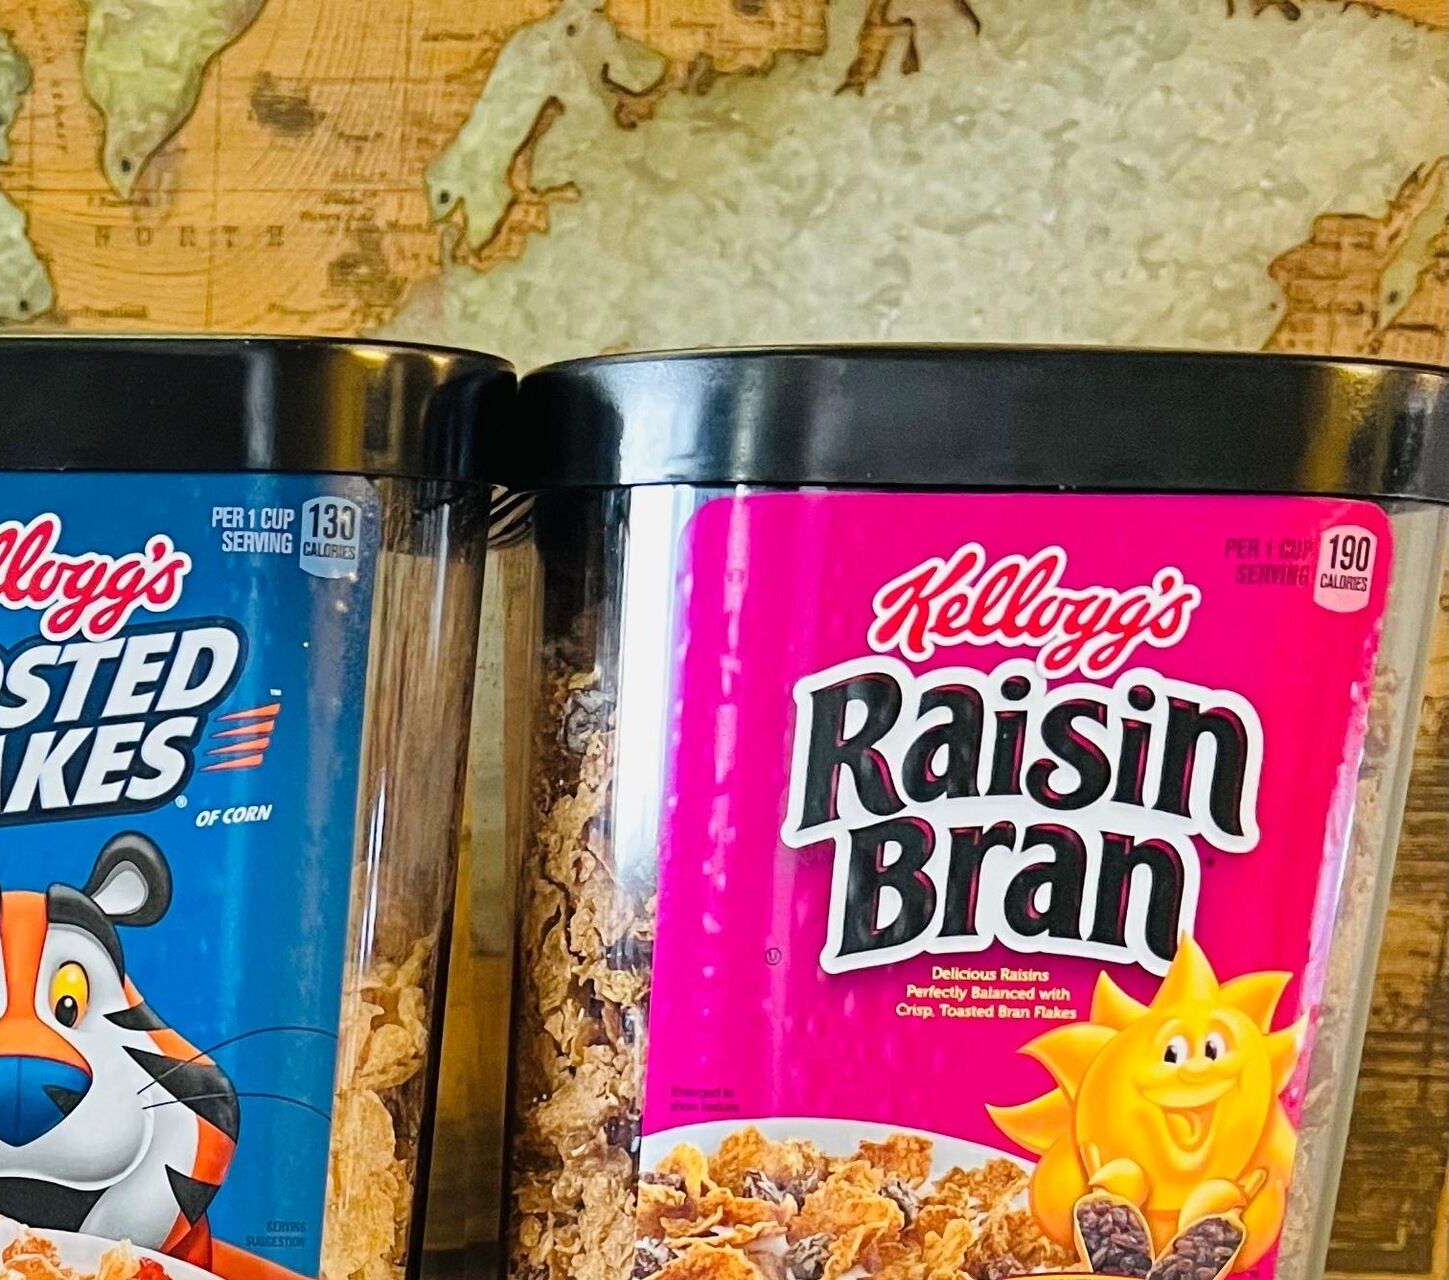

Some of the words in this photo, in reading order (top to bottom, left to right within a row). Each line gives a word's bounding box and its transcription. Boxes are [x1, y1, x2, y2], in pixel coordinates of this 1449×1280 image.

[212, 506, 244, 529] PER
[247, 509, 255, 529] 1
[260, 507, 295, 530] CUP
[309, 503, 354, 541] 130
[221, 530, 293, 554] SERVING
[303, 541, 356, 560] CALORIES
[1224, 538, 1260, 560] PER
[1278, 538, 1314, 561] CUP
[1329, 534, 1371, 572] 190
[1235, 563, 1311, 586] SERVING
[1320, 573, 1368, 592] CALORIES
[871, 545, 1197, 677] Kellogg's
[799, 670, 1249, 836] Raisin
[195, 809, 221, 827] OF
[222, 804, 272, 824] CORN
[835, 818, 1187, 962] Bran
[931, 966, 997, 981] Delicious
[999, 968, 1050, 982] Raisins
[906, 984, 968, 1002] Perfectly
[971, 986, 1036, 1001] Balanced
[1039, 988, 1070, 1001] with
[939, 1004, 995, 1019] Toasted
[998, 1005, 1031, 1019] Bran
[1034, 1006, 1078, 1020] Flakes
